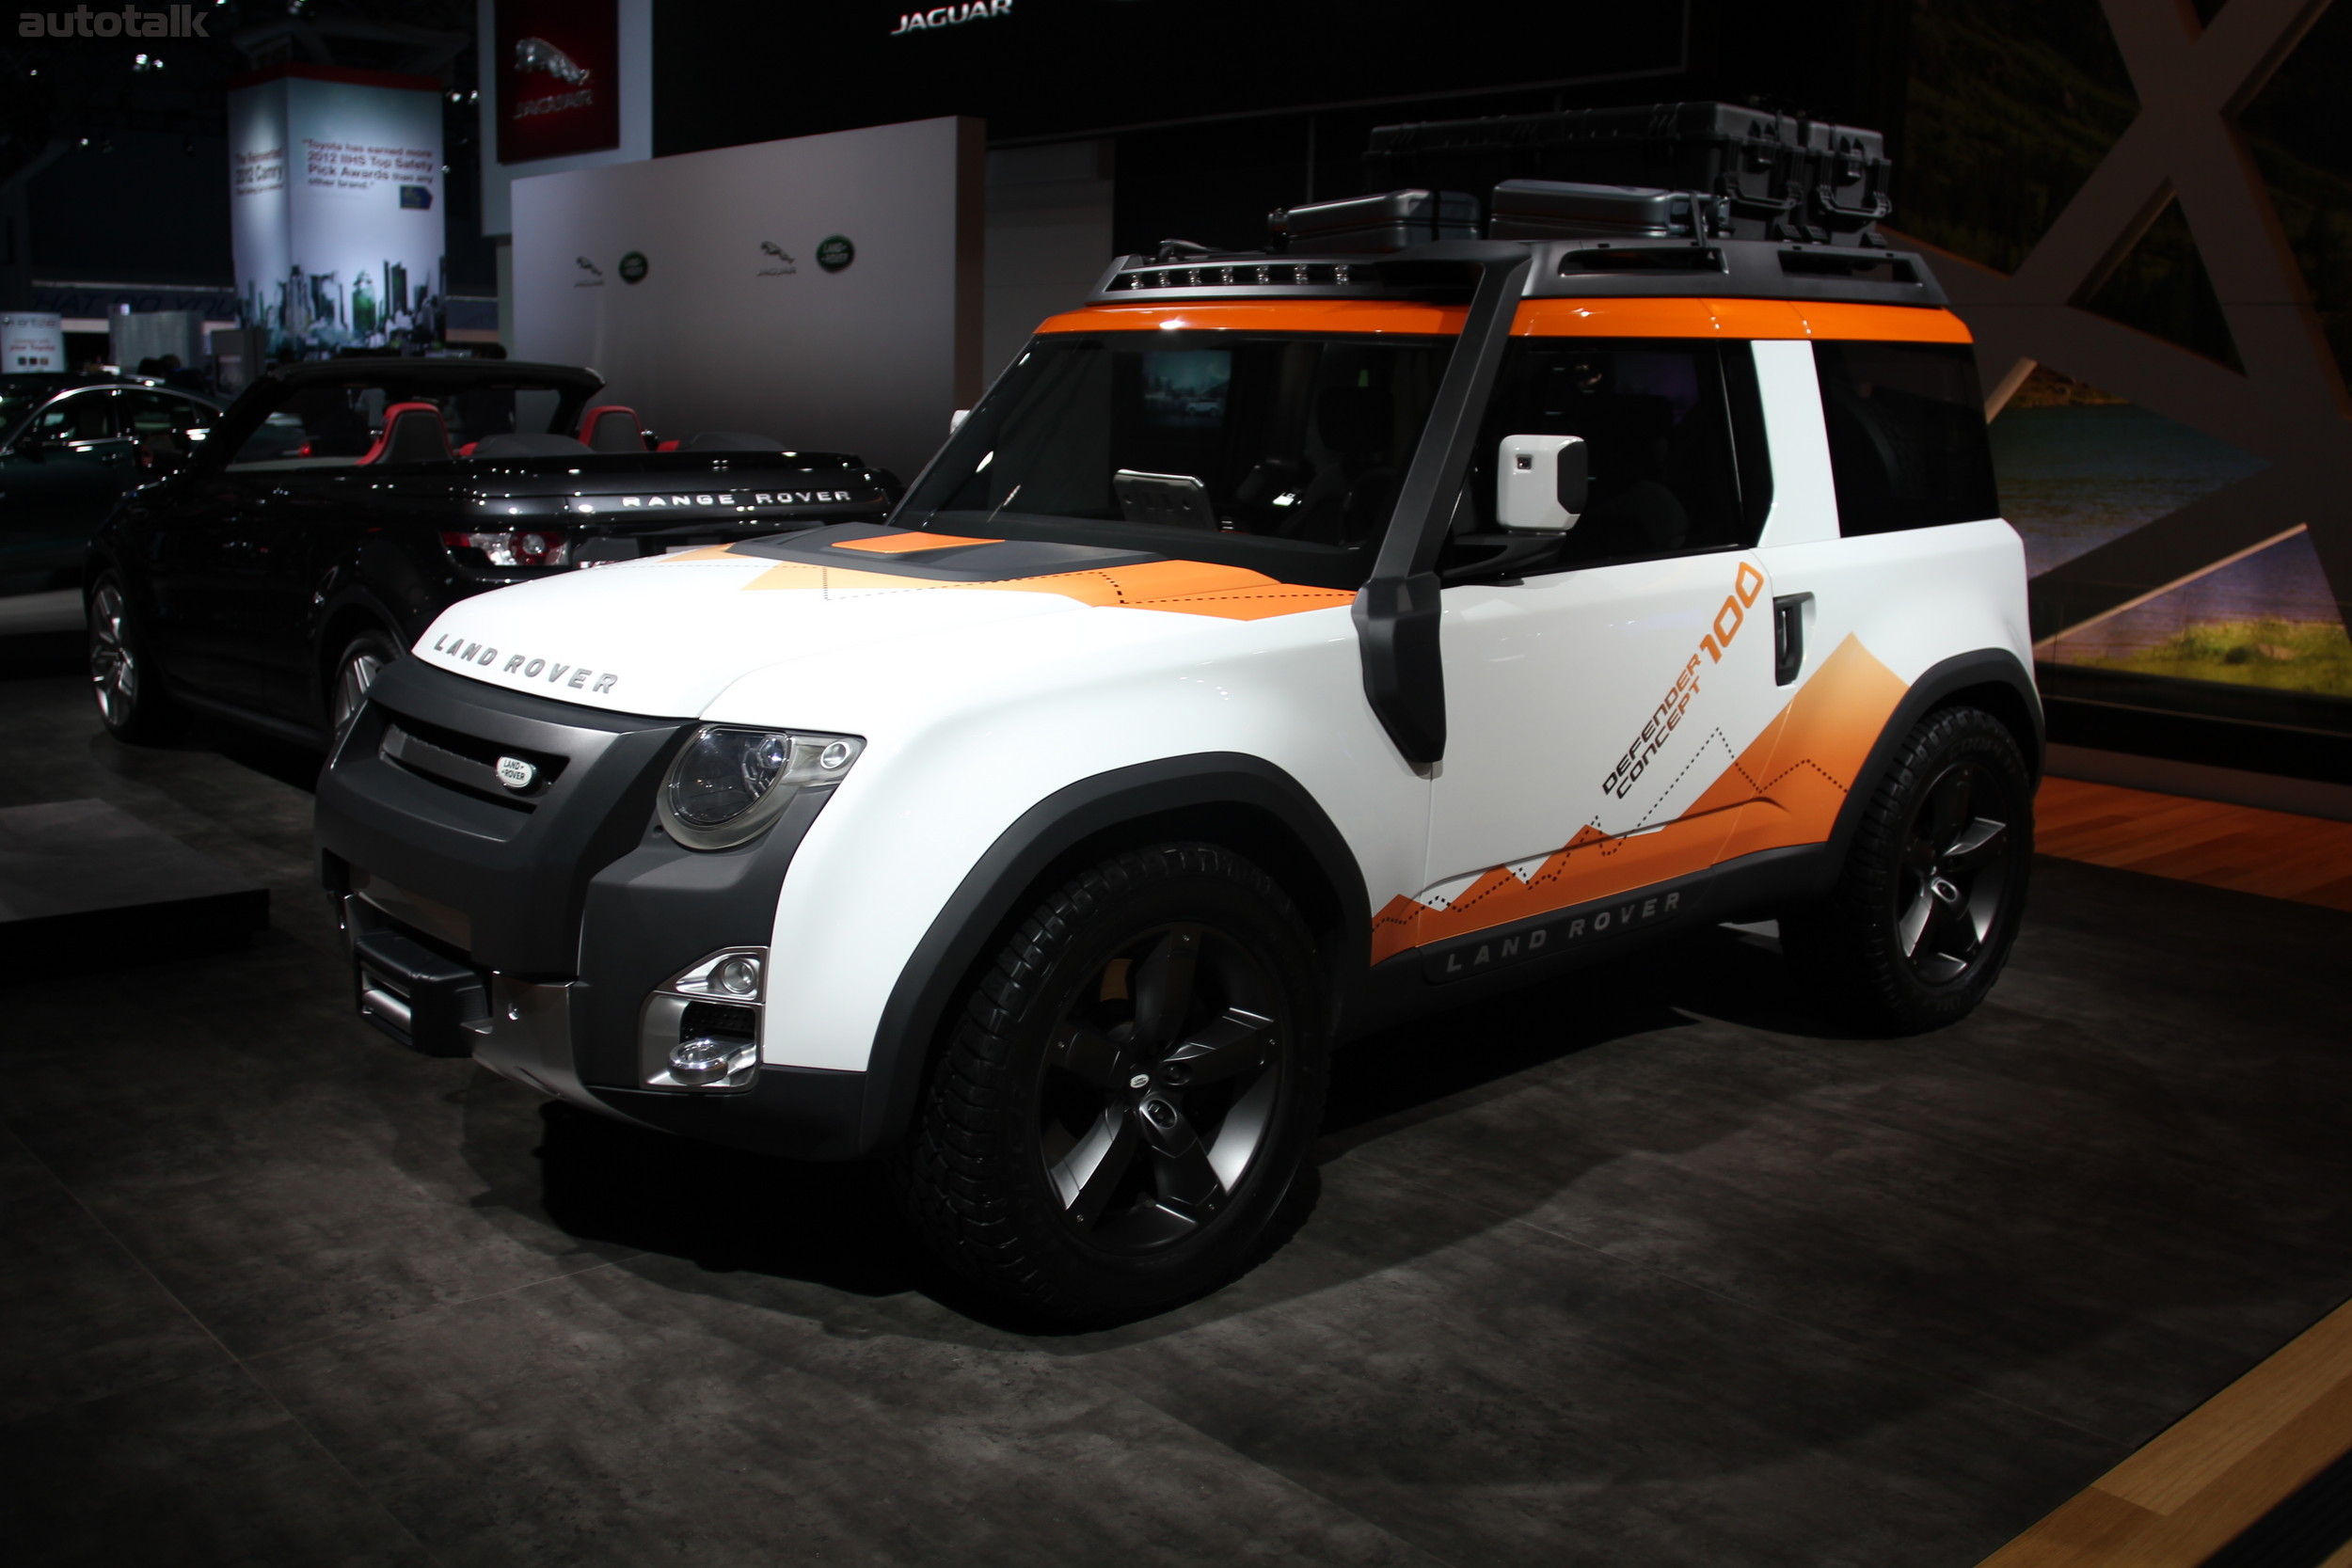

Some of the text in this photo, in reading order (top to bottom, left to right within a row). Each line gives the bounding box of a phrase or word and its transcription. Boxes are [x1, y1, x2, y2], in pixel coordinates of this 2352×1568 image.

[308, 164, 336, 175] Pick
[341, 167, 389, 180] Awards
[370, 156, 391, 168] Top
[395, 158, 433, 172] Safety
[622, 490, 851, 508] RANGE ROVER
[434, 633, 618, 694] LAND ROVER
[1602, 562, 1764, 796] DEFENDER 100
[1616, 675, 1700, 800] CONCEPT
[503, 759, 520, 770] LAND
[504, 769, 526, 781] ROVER
[1446, 892, 1680, 974] LAND ROVER
